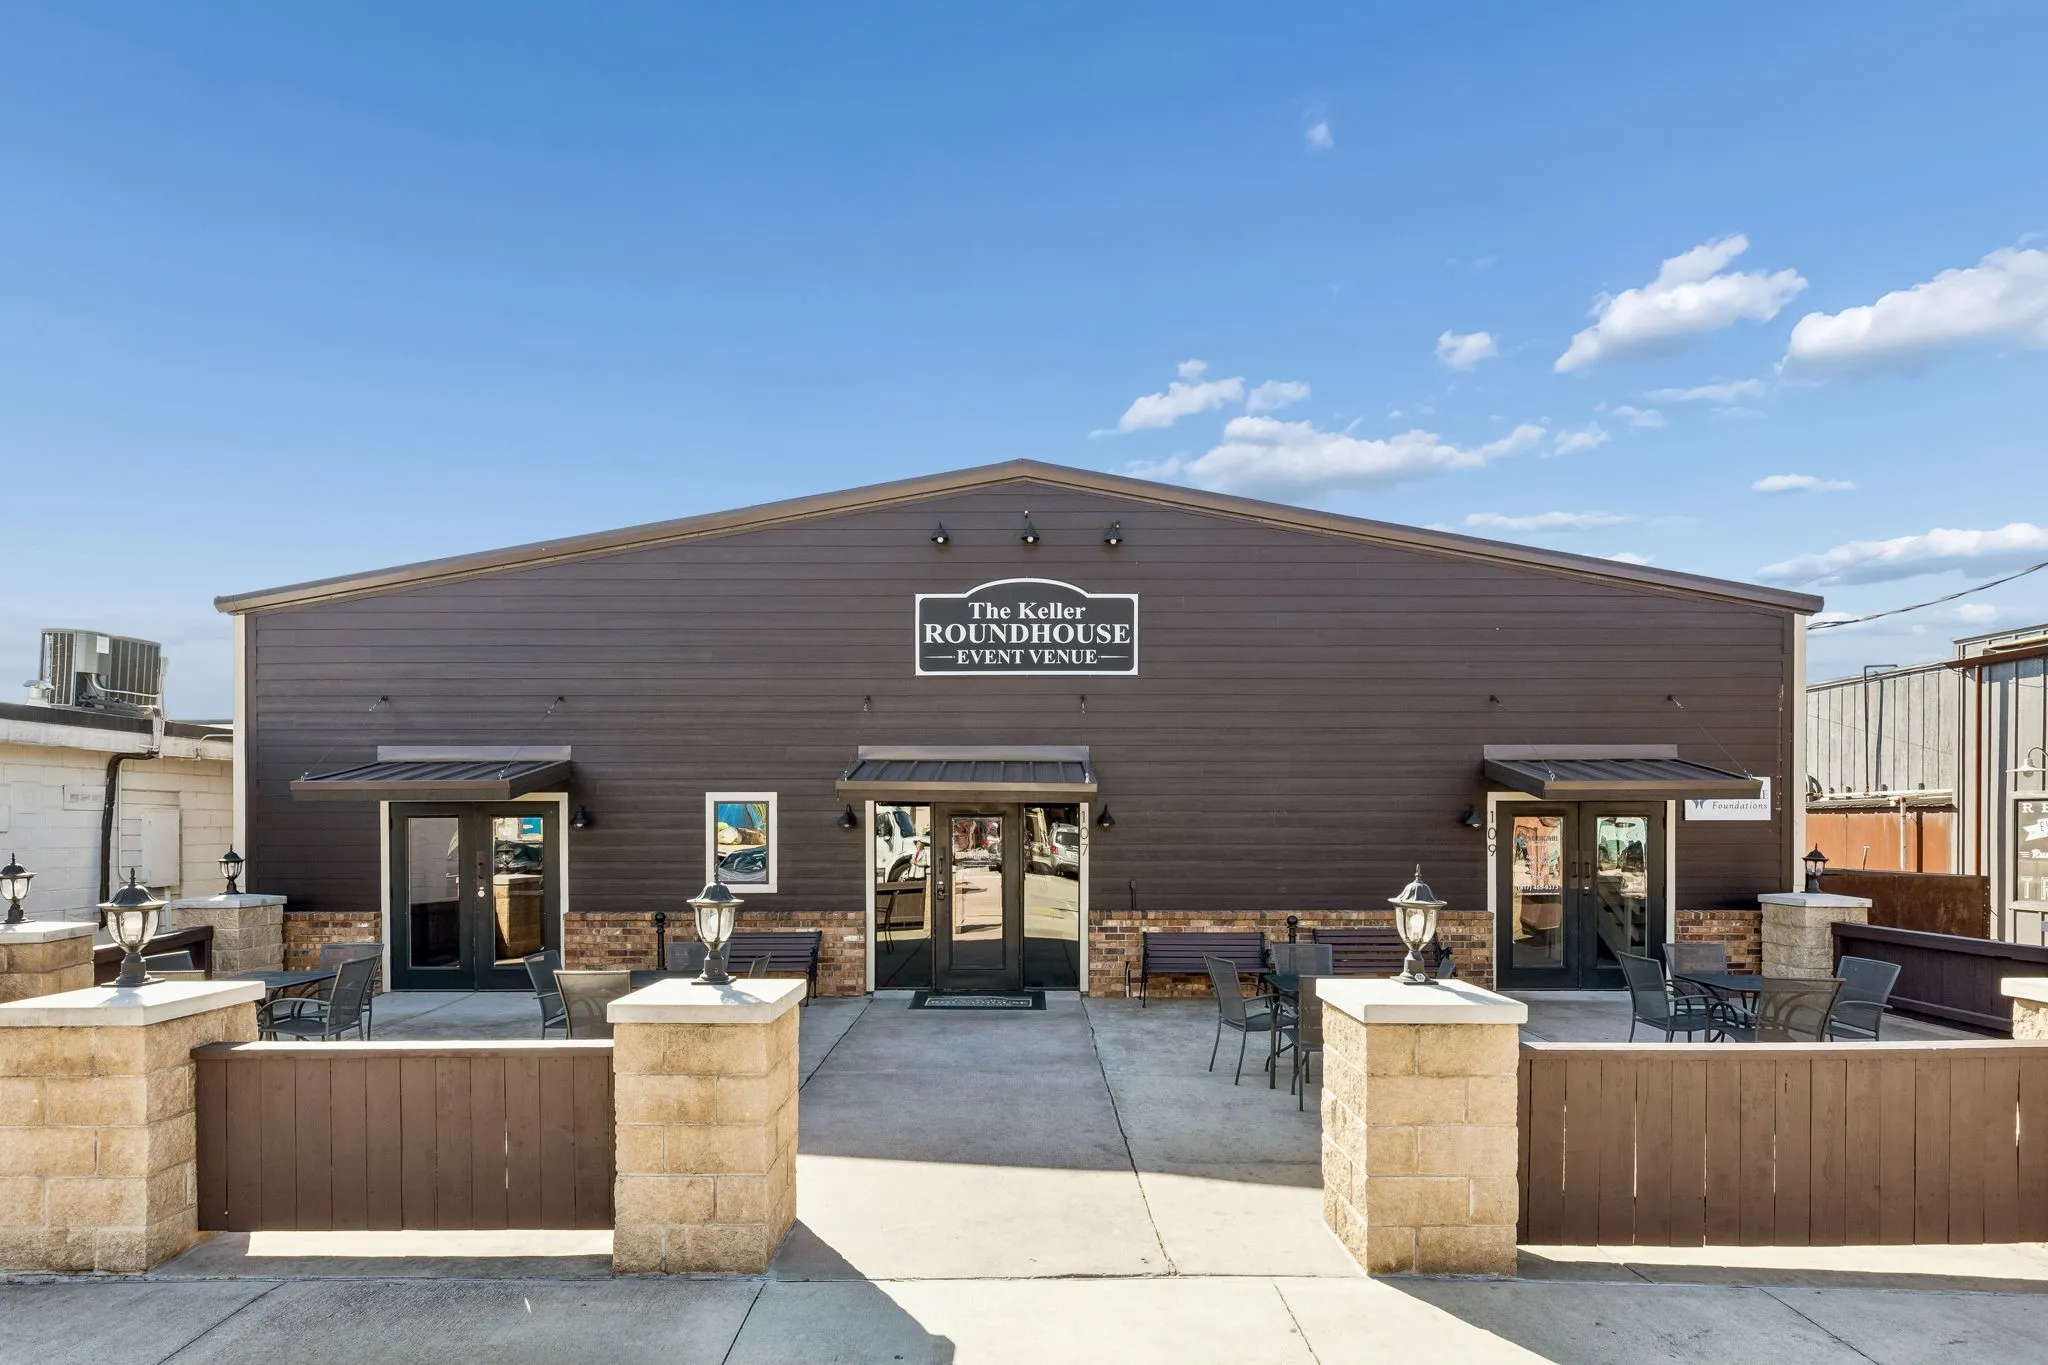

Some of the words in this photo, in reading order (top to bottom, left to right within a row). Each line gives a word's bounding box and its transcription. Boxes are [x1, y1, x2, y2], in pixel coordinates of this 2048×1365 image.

[968, 602, 1011, 619] The
[1017, 602, 1086, 619] Keller
[923, 623, 1131, 644] ROUNDHOUSE
[956, 649, 1024, 664] EVENT
[1029, 649, 1098, 664] VENUE
[1712, 801, 1768, 810] Foundations
[1080, 810, 1089, 857] 107
[1488, 810, 1497, 857] 109
